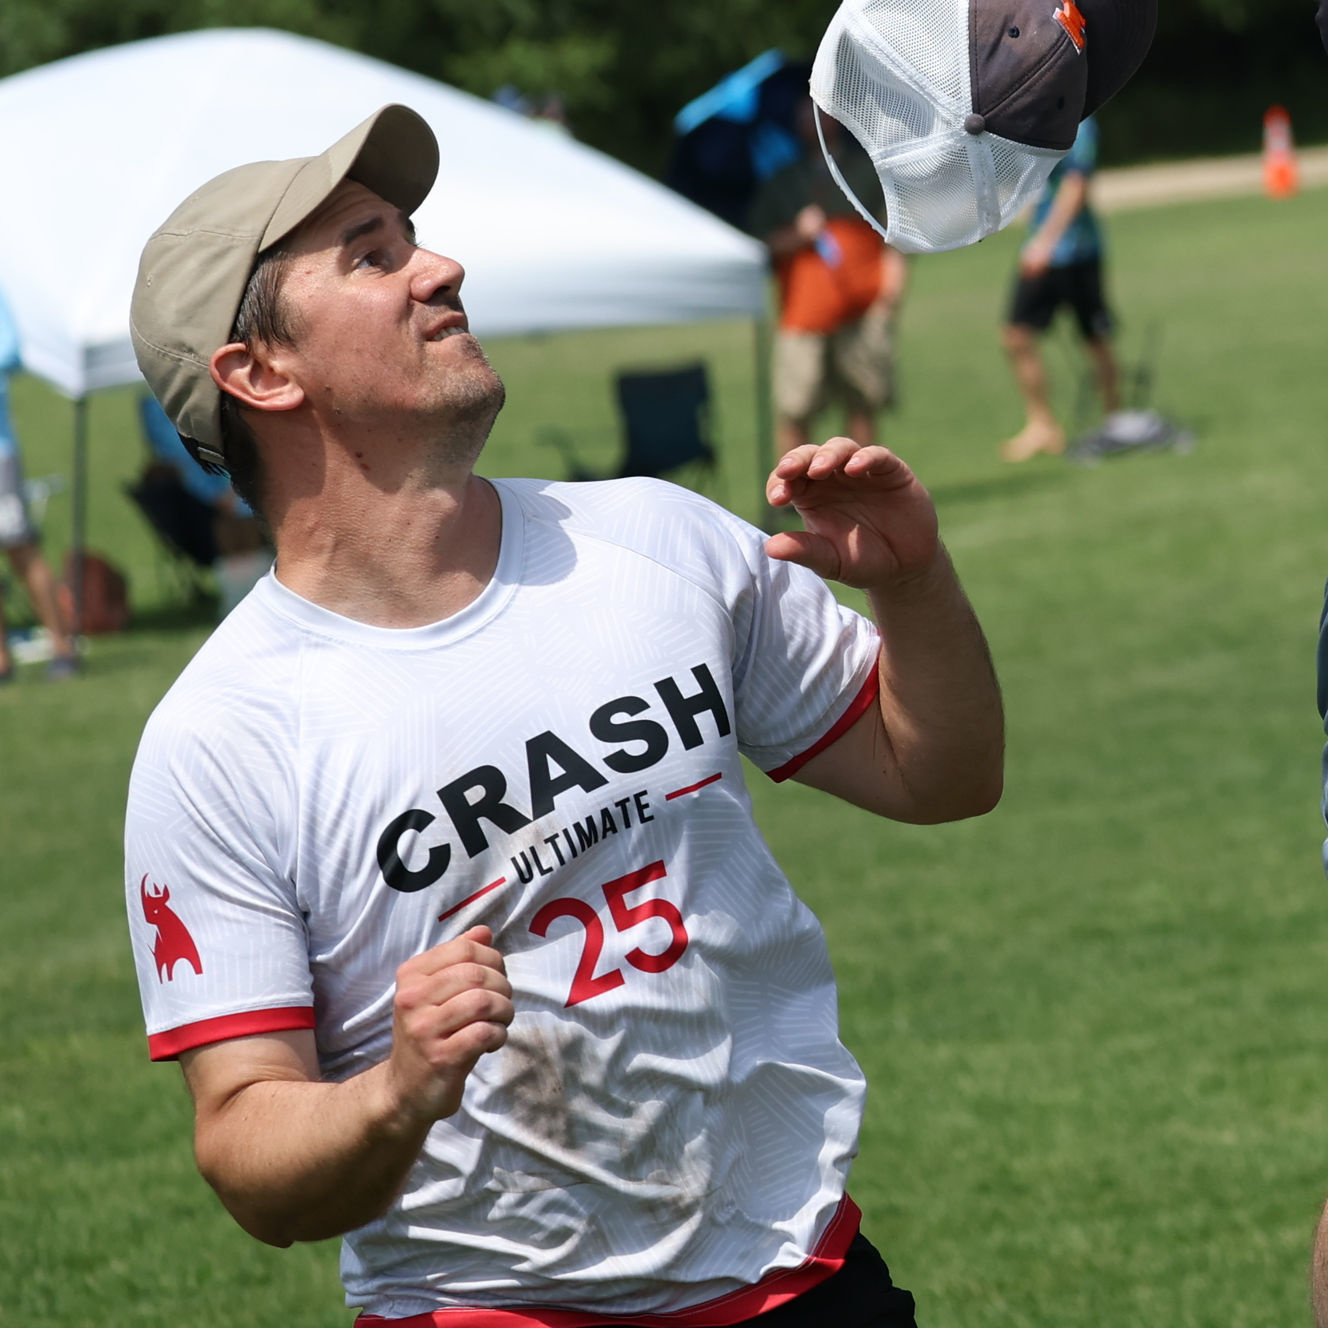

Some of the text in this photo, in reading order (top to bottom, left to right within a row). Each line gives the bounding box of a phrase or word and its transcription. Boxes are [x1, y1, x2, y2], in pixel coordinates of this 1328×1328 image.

[376, 663, 731, 893] CRASH
[511, 789, 655, 885] ULTIMATE
[529, 860, 688, 1008] 25
